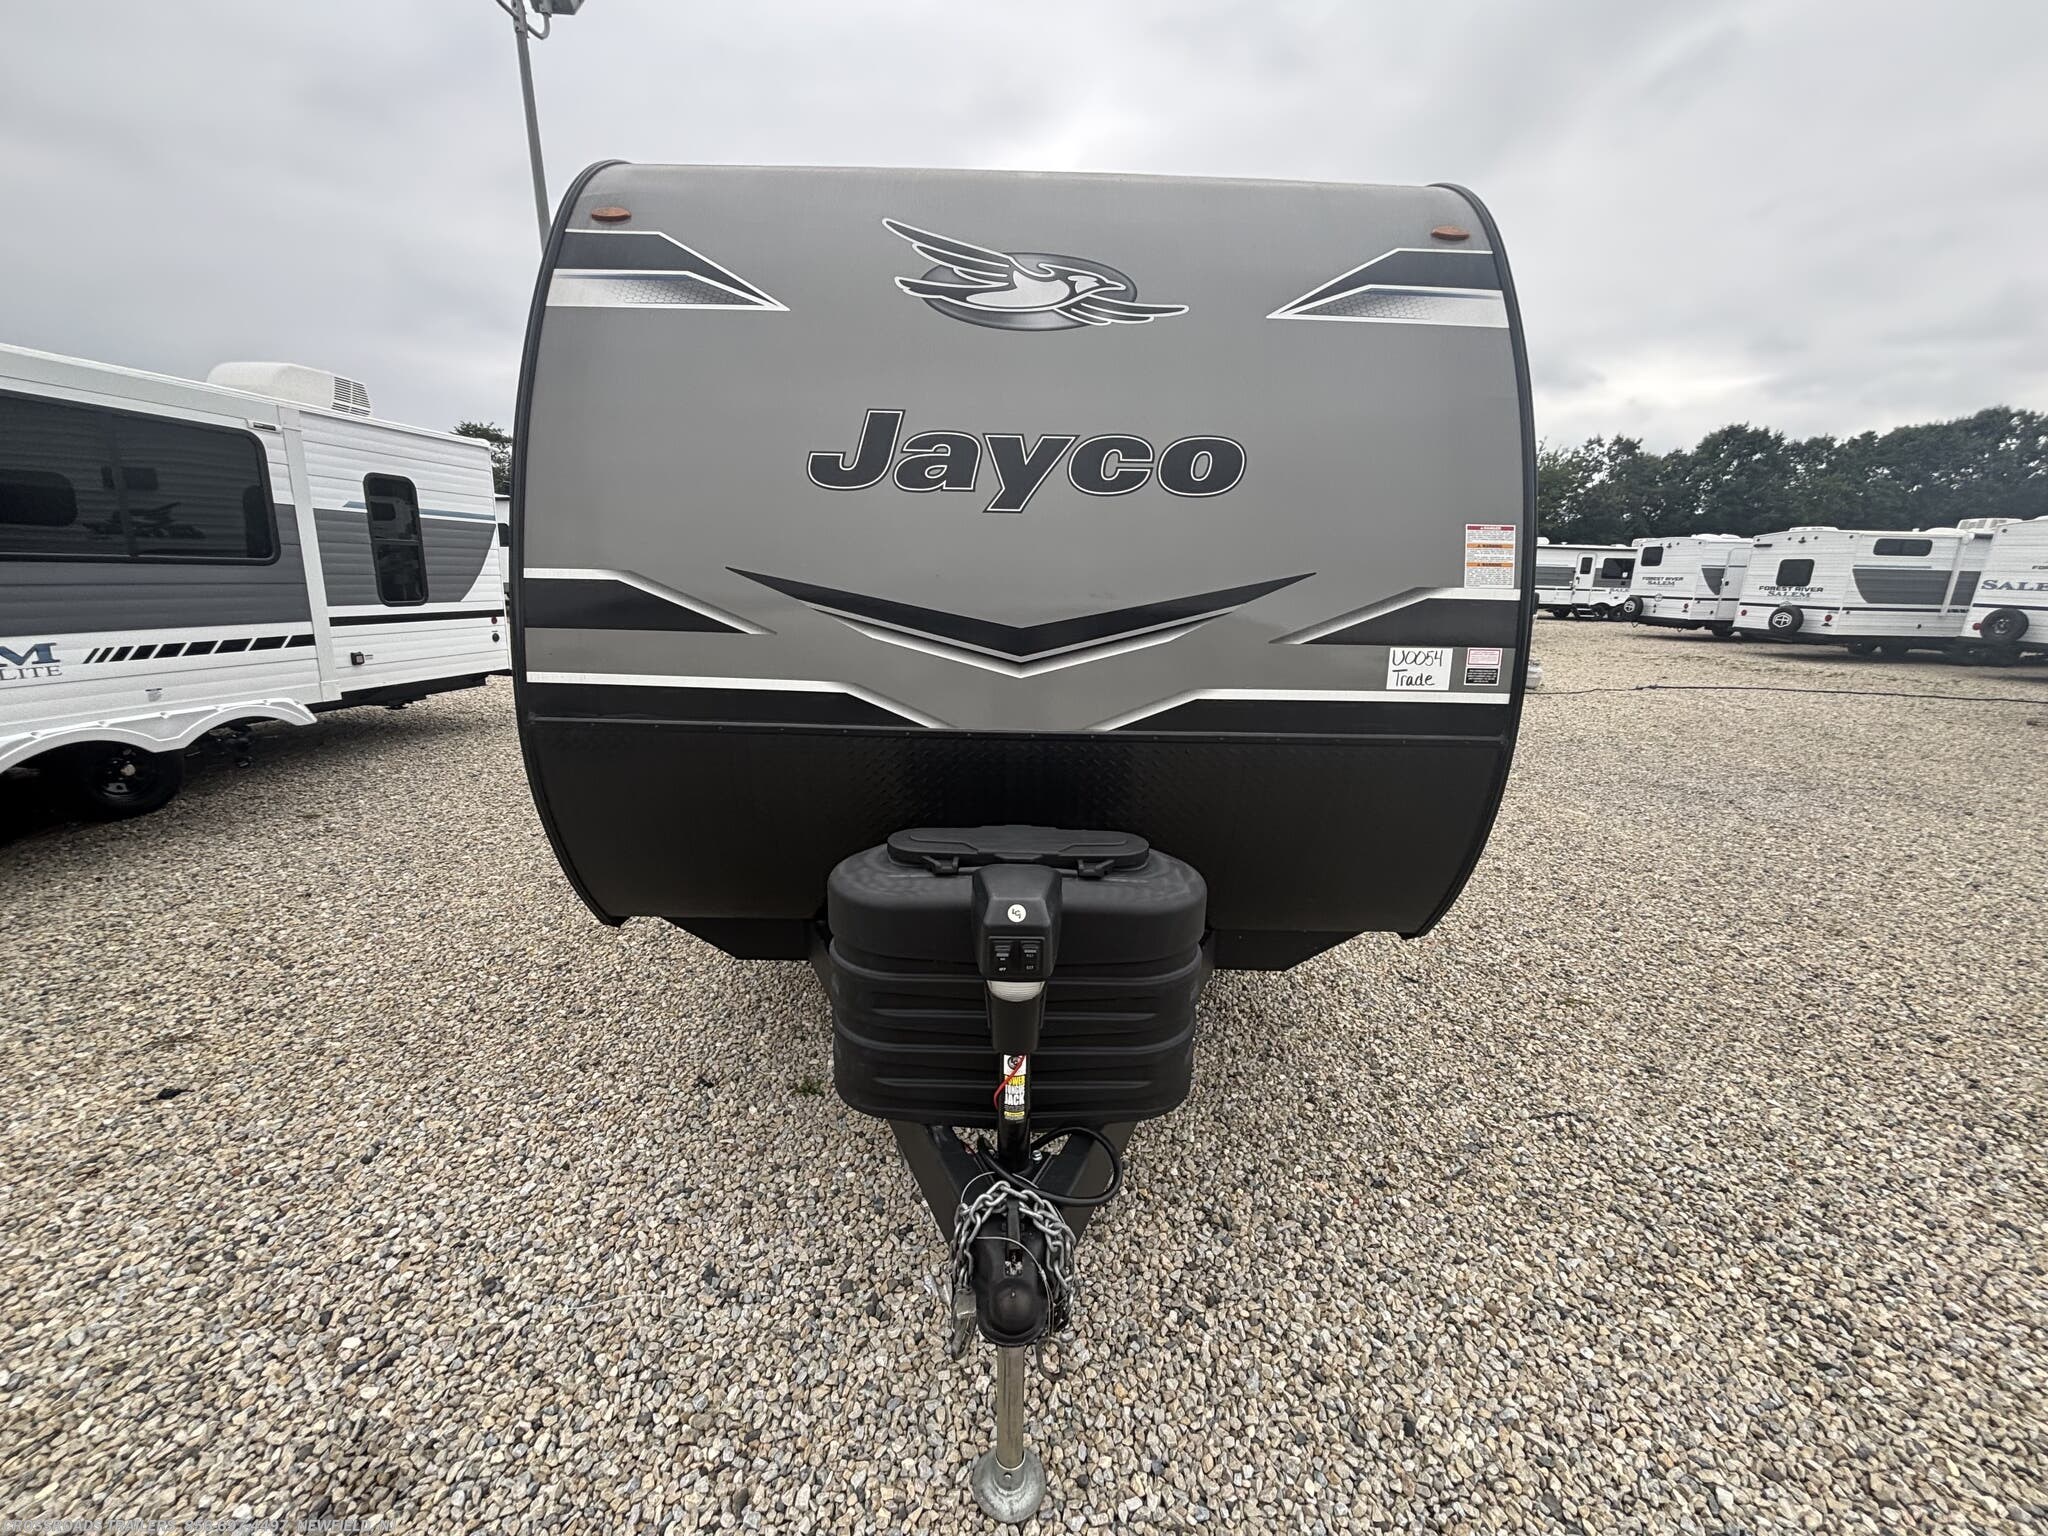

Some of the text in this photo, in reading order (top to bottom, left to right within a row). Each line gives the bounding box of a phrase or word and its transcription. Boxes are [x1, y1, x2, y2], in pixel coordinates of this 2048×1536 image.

[807, 408, 1248, 514] Jayco
[1767, 590, 1811, 598] SALEM
[1392, 668, 1436, 687] Trade
[1005, 1093, 1025, 1106] JACK
